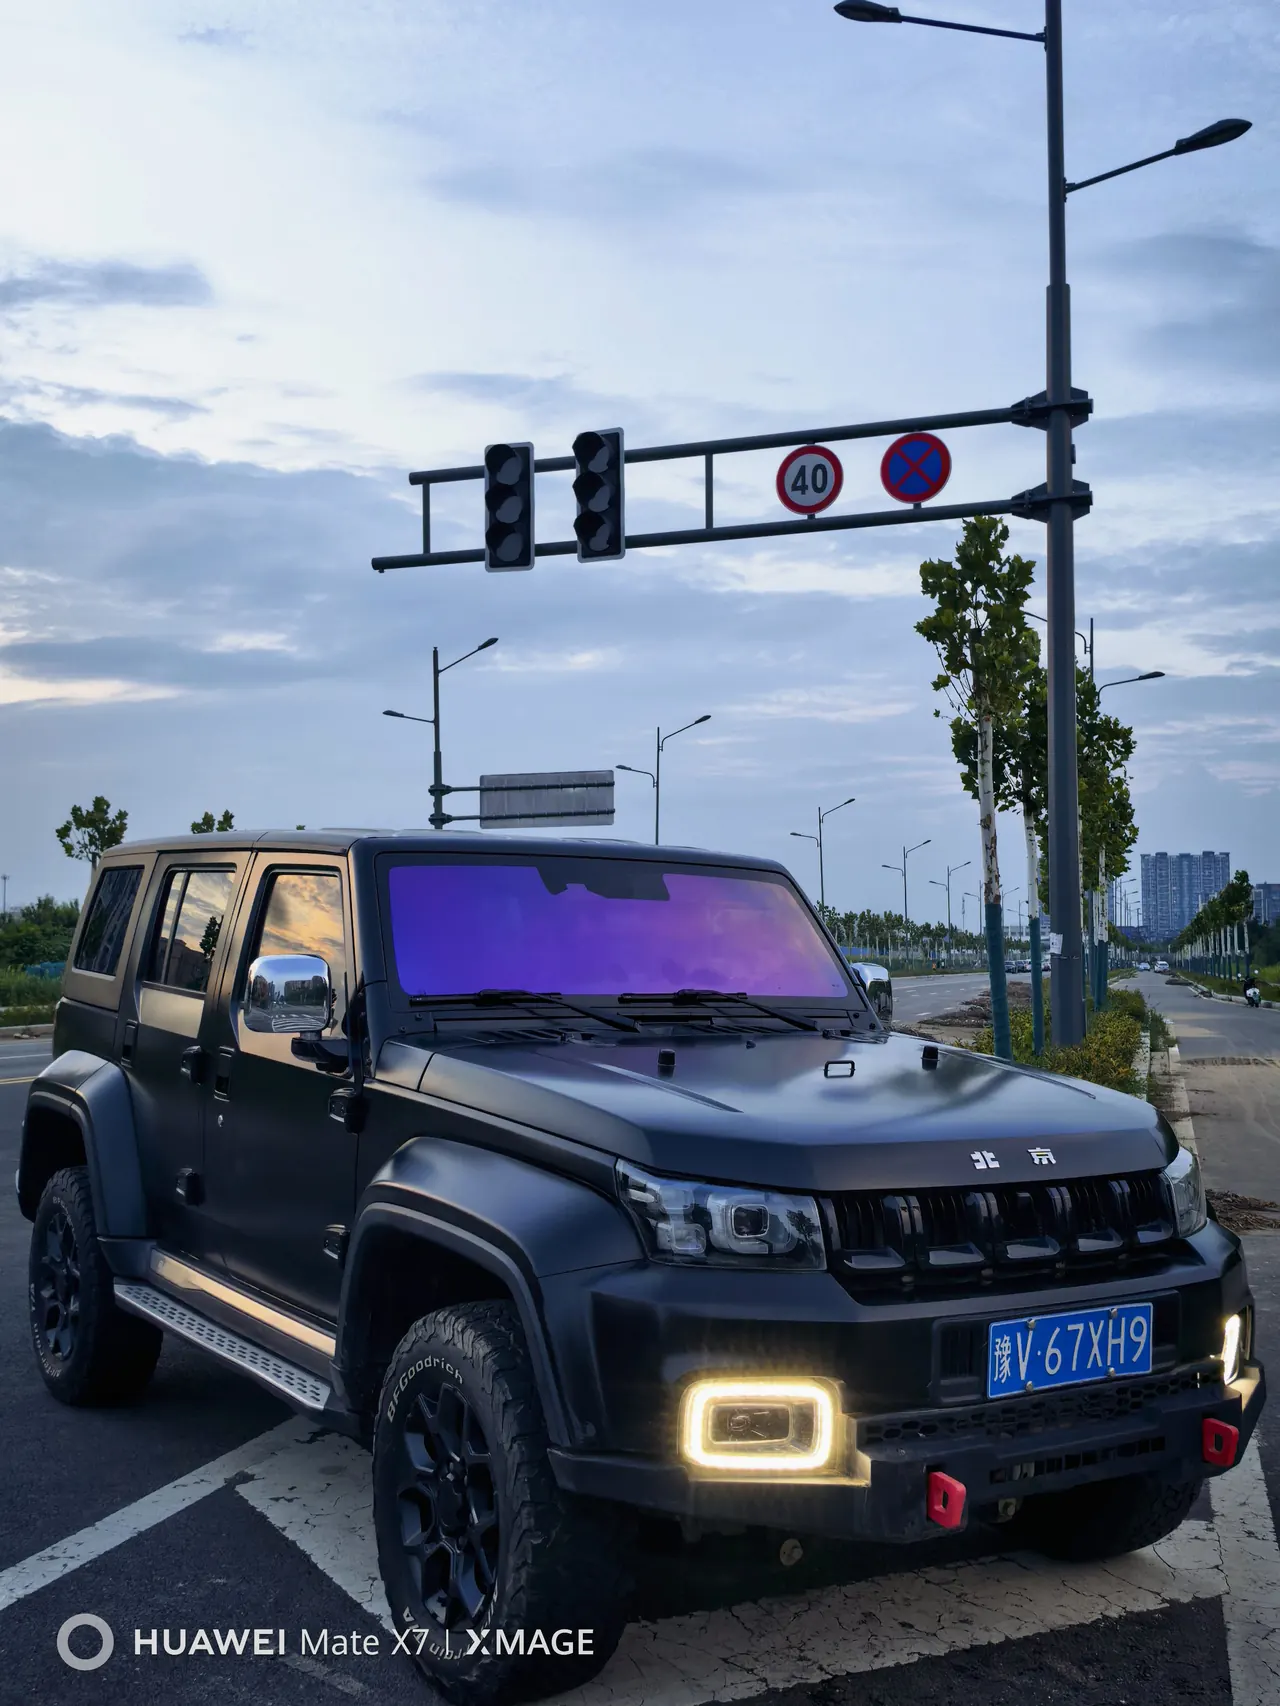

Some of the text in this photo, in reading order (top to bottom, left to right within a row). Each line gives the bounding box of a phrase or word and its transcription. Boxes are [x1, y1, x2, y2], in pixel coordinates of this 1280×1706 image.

[791, 463, 828, 495] 40
[970, 1147, 1057, 1170] 北京
[387, 1354, 463, 1423] BFGoodrich
